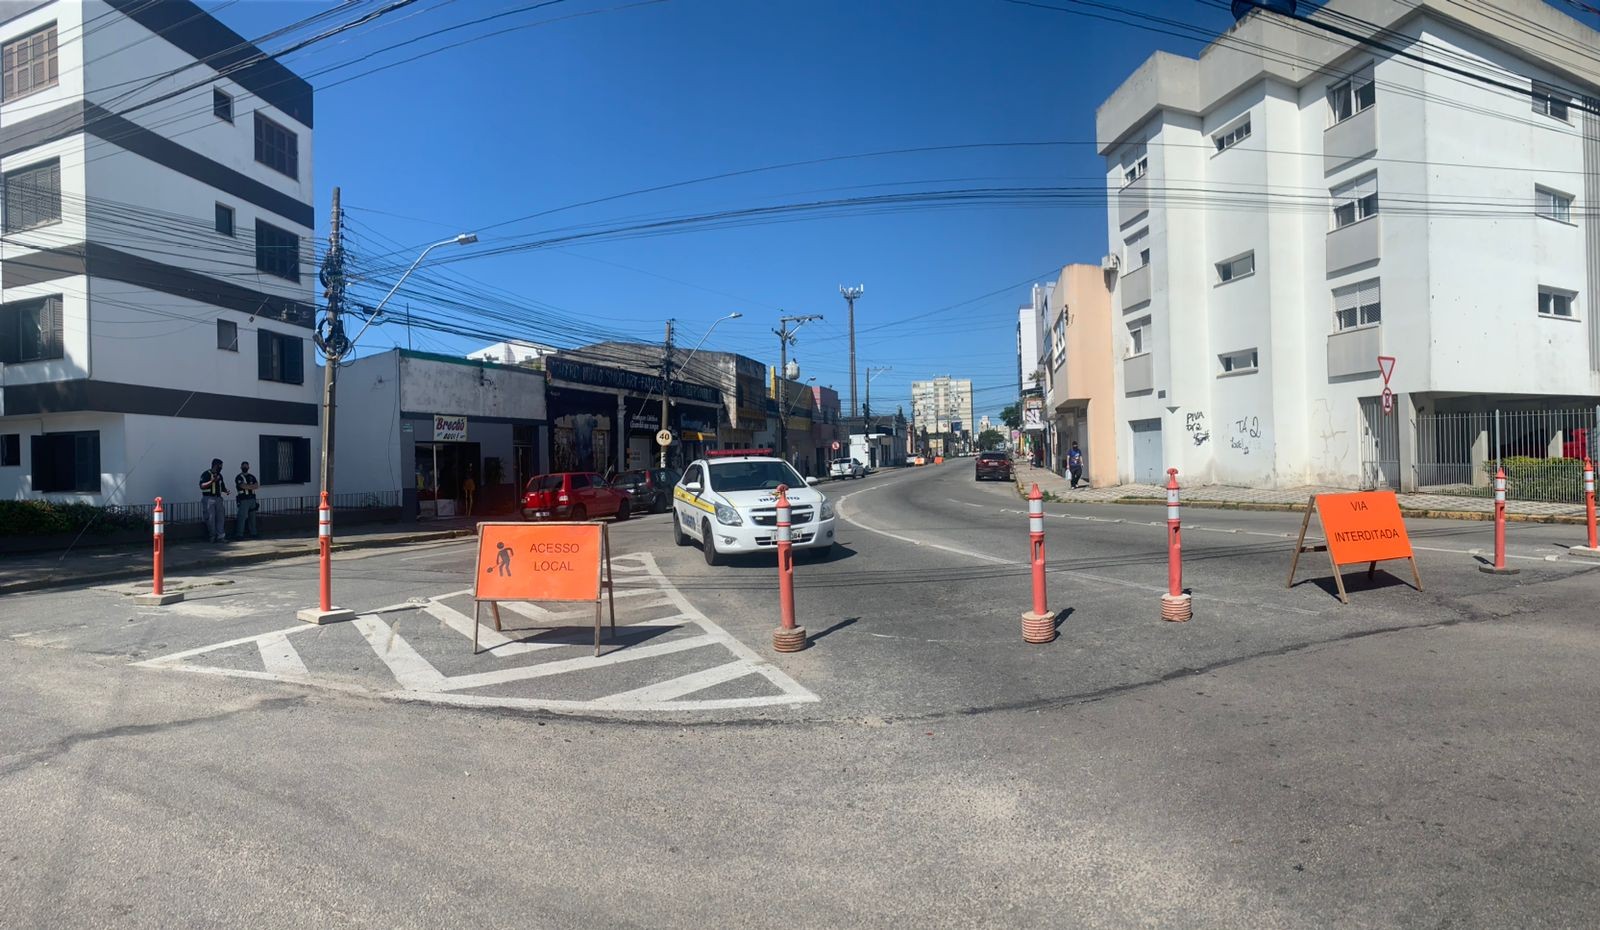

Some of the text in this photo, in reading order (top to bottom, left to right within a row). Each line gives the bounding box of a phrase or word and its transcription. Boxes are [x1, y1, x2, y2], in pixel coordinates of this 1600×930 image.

[1350, 501, 1368, 512] VIA
[1334, 529, 1400, 542] INTERDITADA
[529, 543, 580, 553] ACESSO
[533, 561, 574, 571] LOCAL
